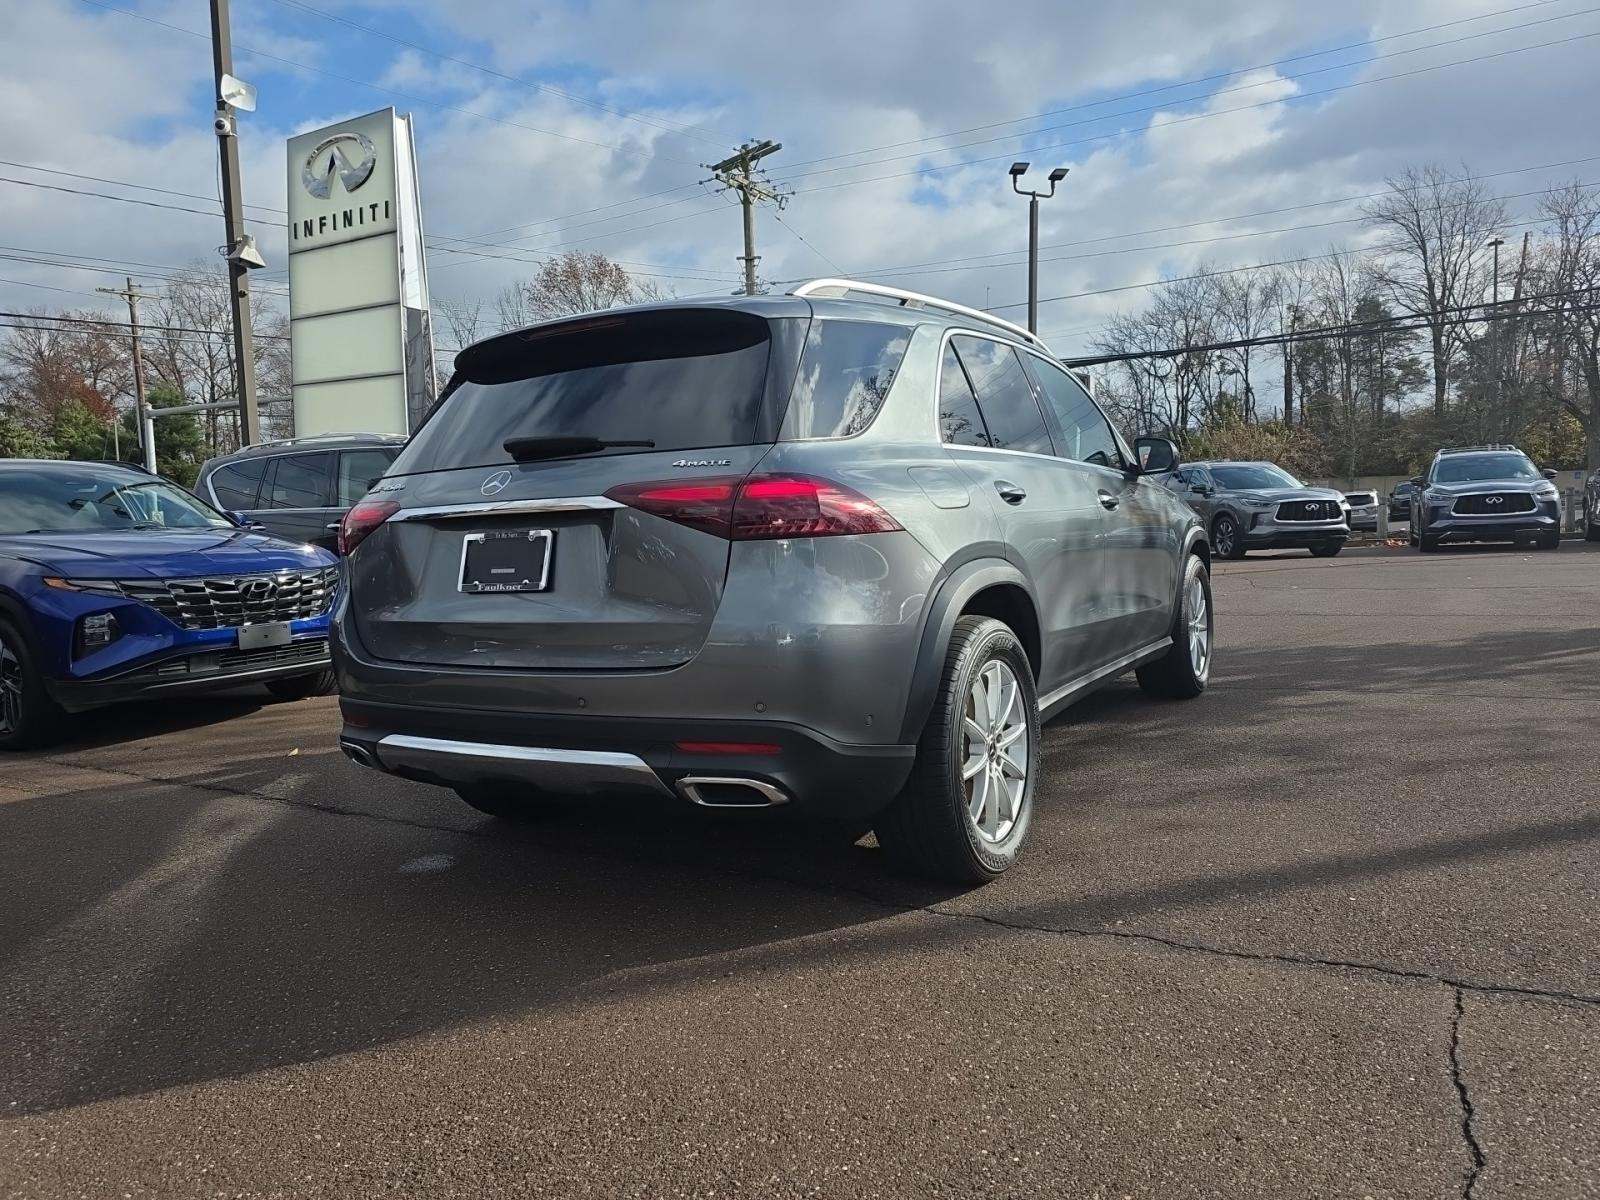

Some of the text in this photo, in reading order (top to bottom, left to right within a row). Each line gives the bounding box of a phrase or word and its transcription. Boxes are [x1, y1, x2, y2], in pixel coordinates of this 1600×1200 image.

[293, 200, 390, 239] INFINITI
[672, 459, 731, 467] 4MATIC
[478, 583, 522, 591] Faulkner
